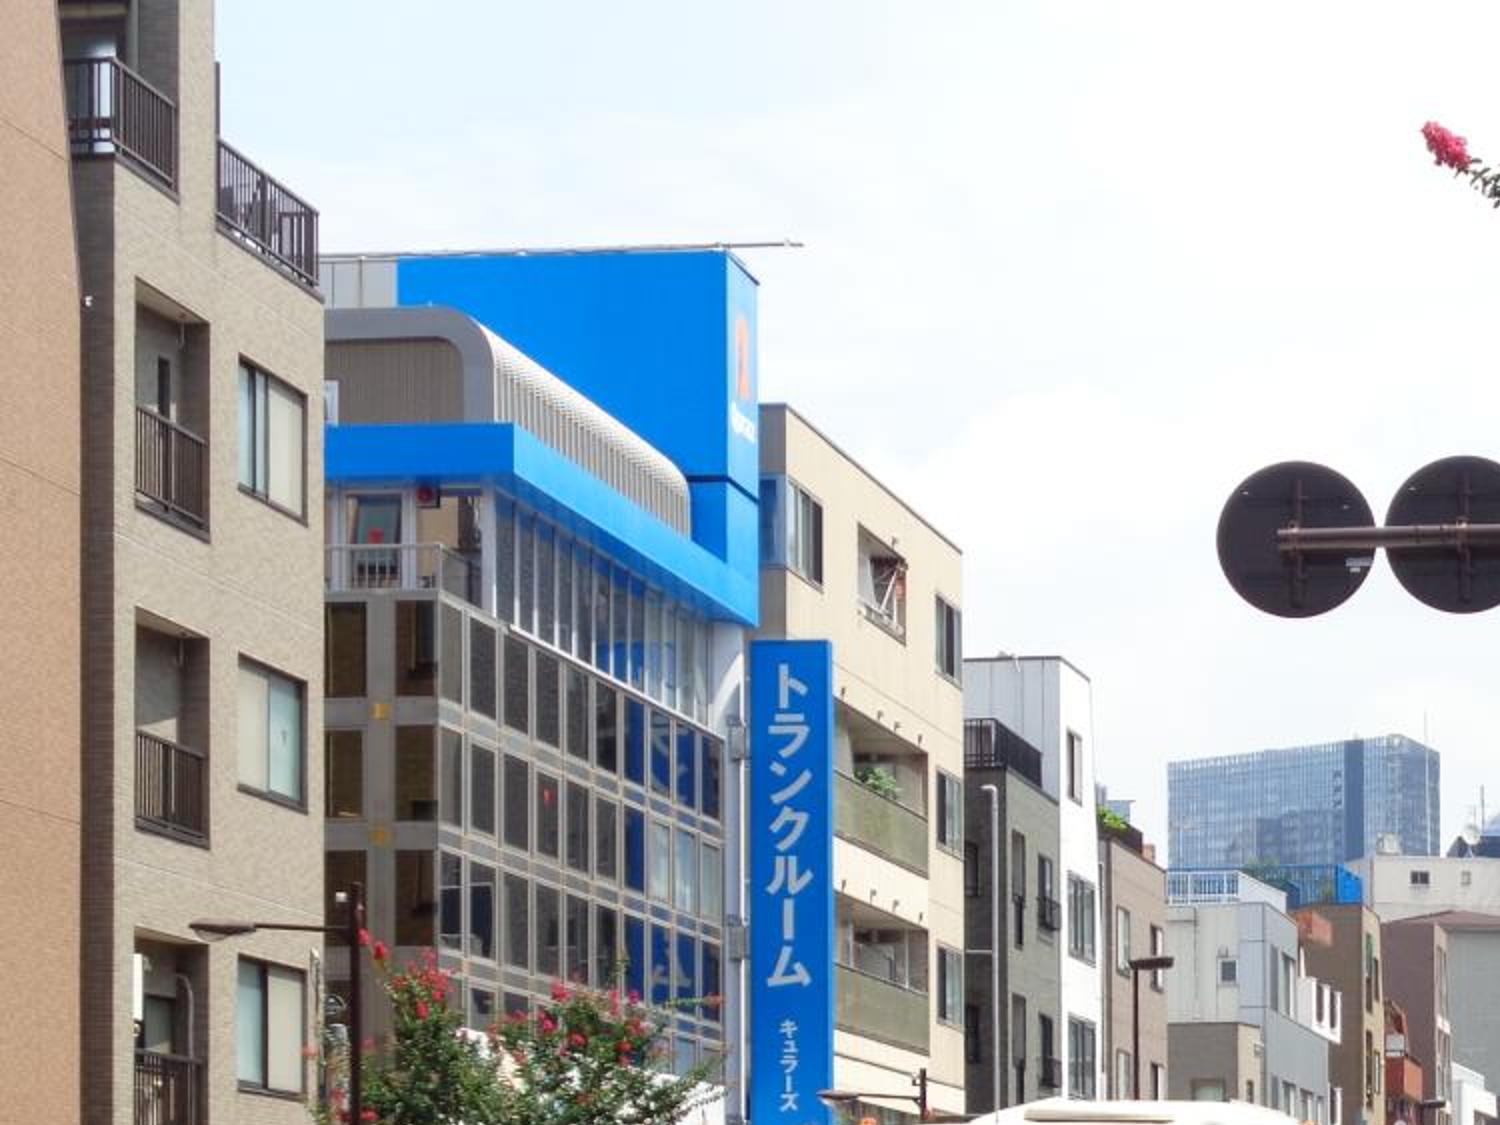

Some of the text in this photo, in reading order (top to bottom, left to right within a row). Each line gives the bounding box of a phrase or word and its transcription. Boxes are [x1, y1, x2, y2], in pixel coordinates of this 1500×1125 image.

[767, 663, 812, 988] トランクルーム
[779, 1019, 799, 1113] キュラーズ
